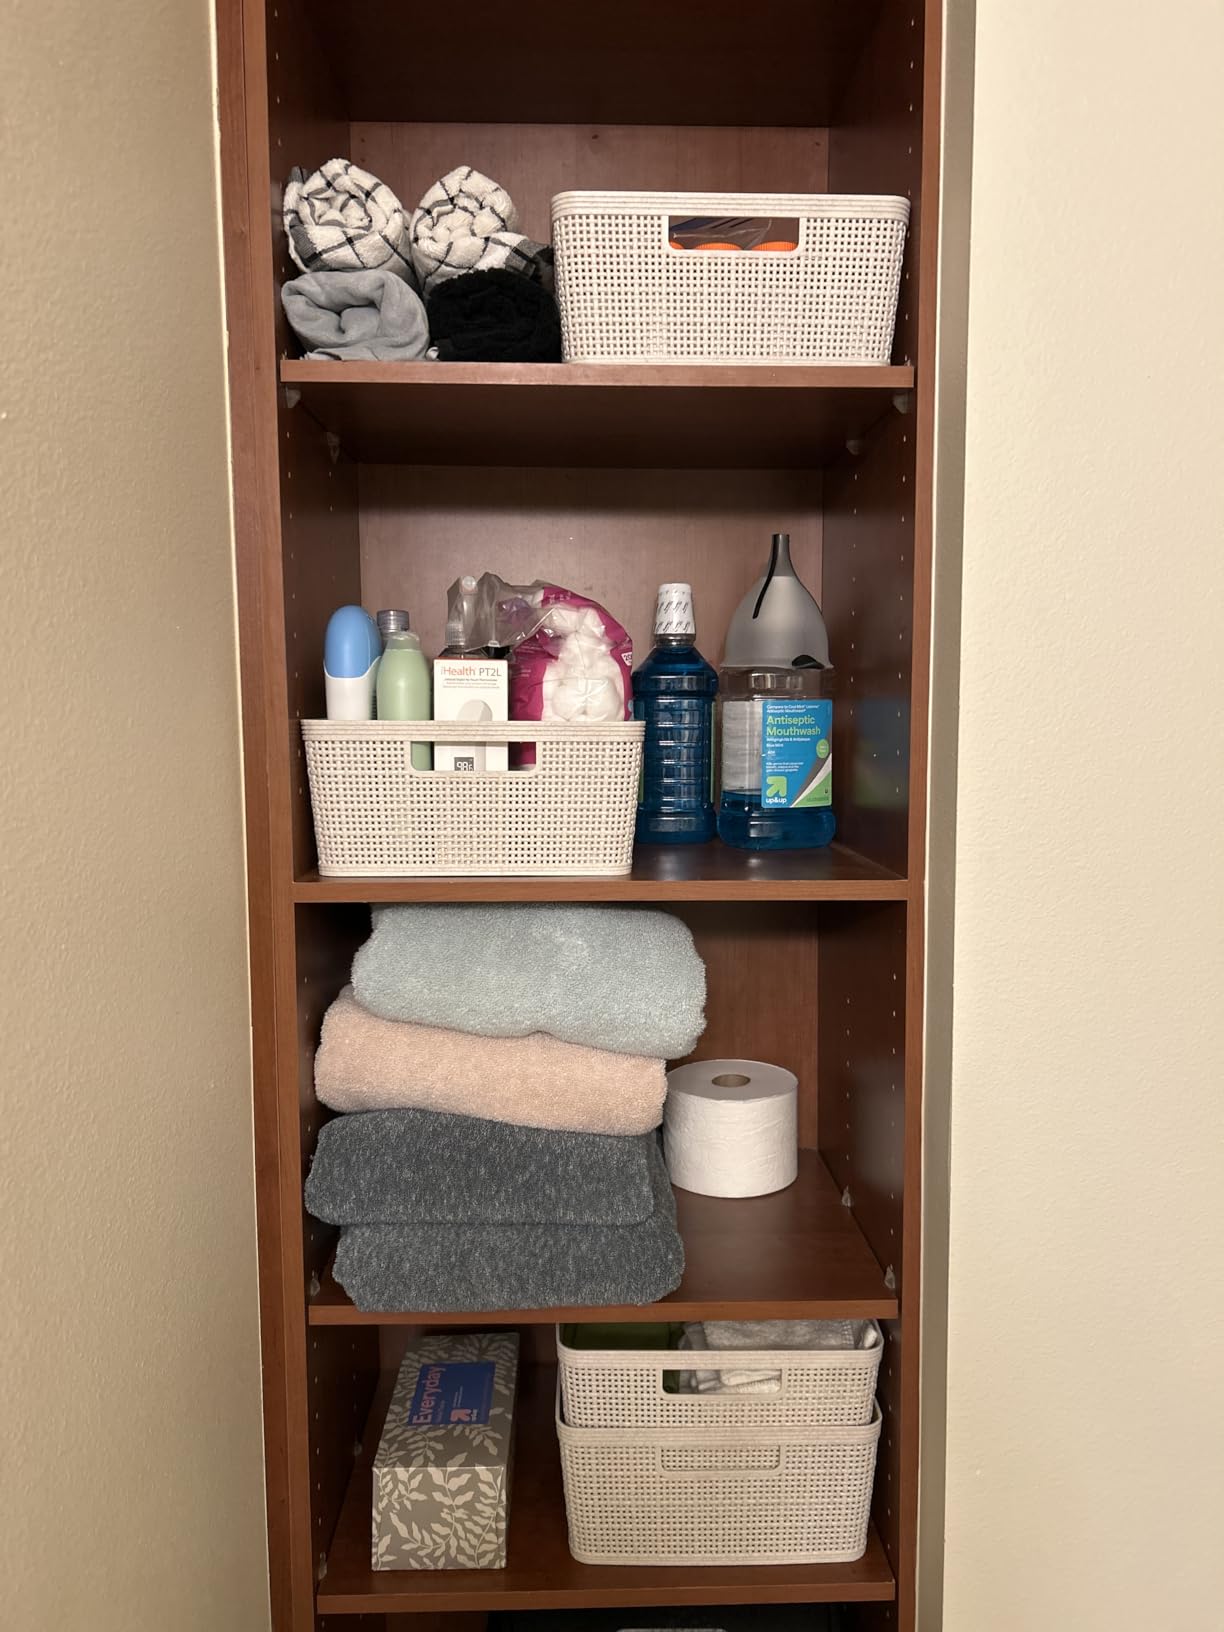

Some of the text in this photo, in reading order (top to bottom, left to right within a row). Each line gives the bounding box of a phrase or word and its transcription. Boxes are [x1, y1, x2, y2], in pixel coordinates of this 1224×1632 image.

[440, 665, 502, 677] iHealth PT2L
[766, 714, 816, 727] Antiseptic
[766, 726, 821, 736] Mouthwash
[765, 797, 788, 805] up&up
[412, 1366, 447, 1425] Everyday
